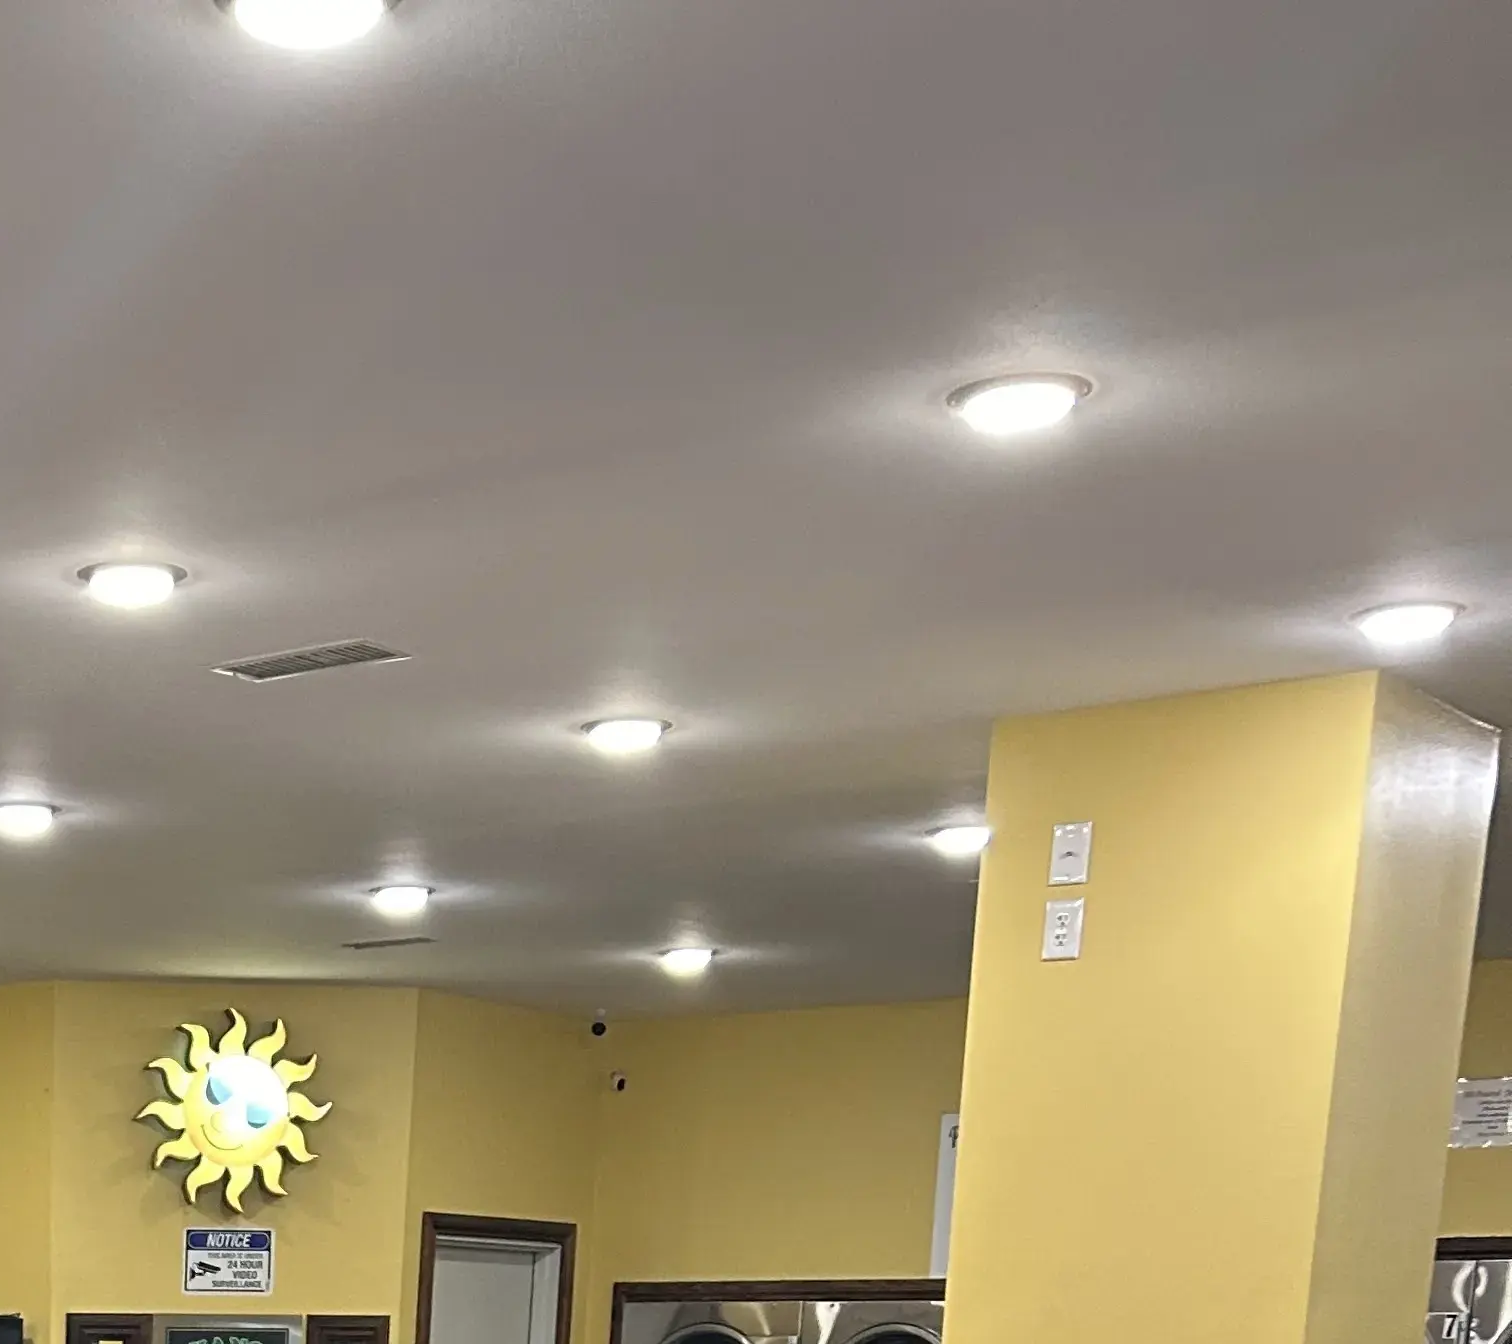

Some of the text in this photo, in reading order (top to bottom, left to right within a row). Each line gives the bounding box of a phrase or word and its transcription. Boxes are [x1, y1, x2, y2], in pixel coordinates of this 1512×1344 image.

[206, 1233, 251, 1247] NOTICE
[228, 1261, 263, 1269] 24 HOUR
[233, 1271, 258, 1279] VIDEO
[1446, 1314, 1457, 1337] 7
